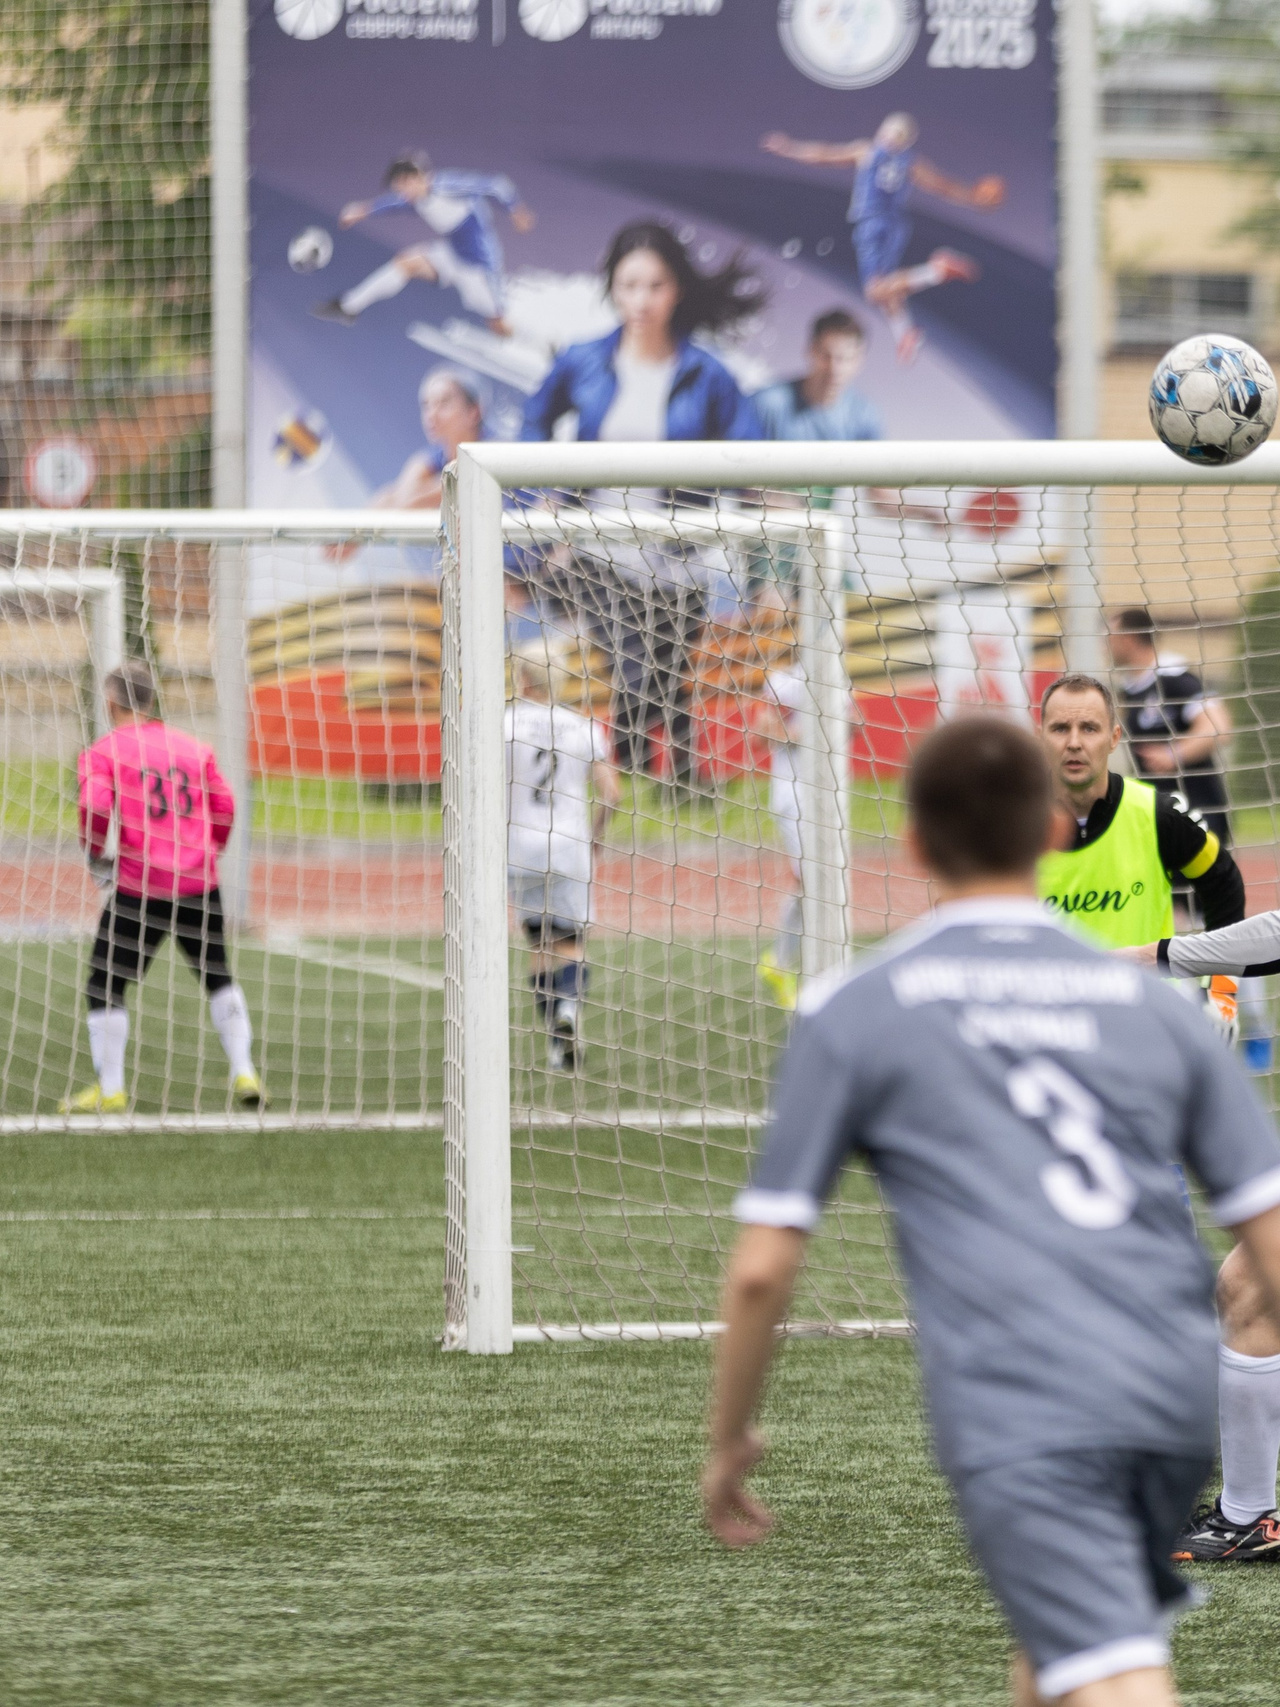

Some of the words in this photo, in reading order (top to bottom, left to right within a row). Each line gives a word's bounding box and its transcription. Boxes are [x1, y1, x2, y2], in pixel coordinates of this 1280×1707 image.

[926, 18, 1037, 70] 2025
[140, 767, 192, 818] 33
[533, 749, 559, 804] 2
[1005, 1056, 1138, 1230] 3
